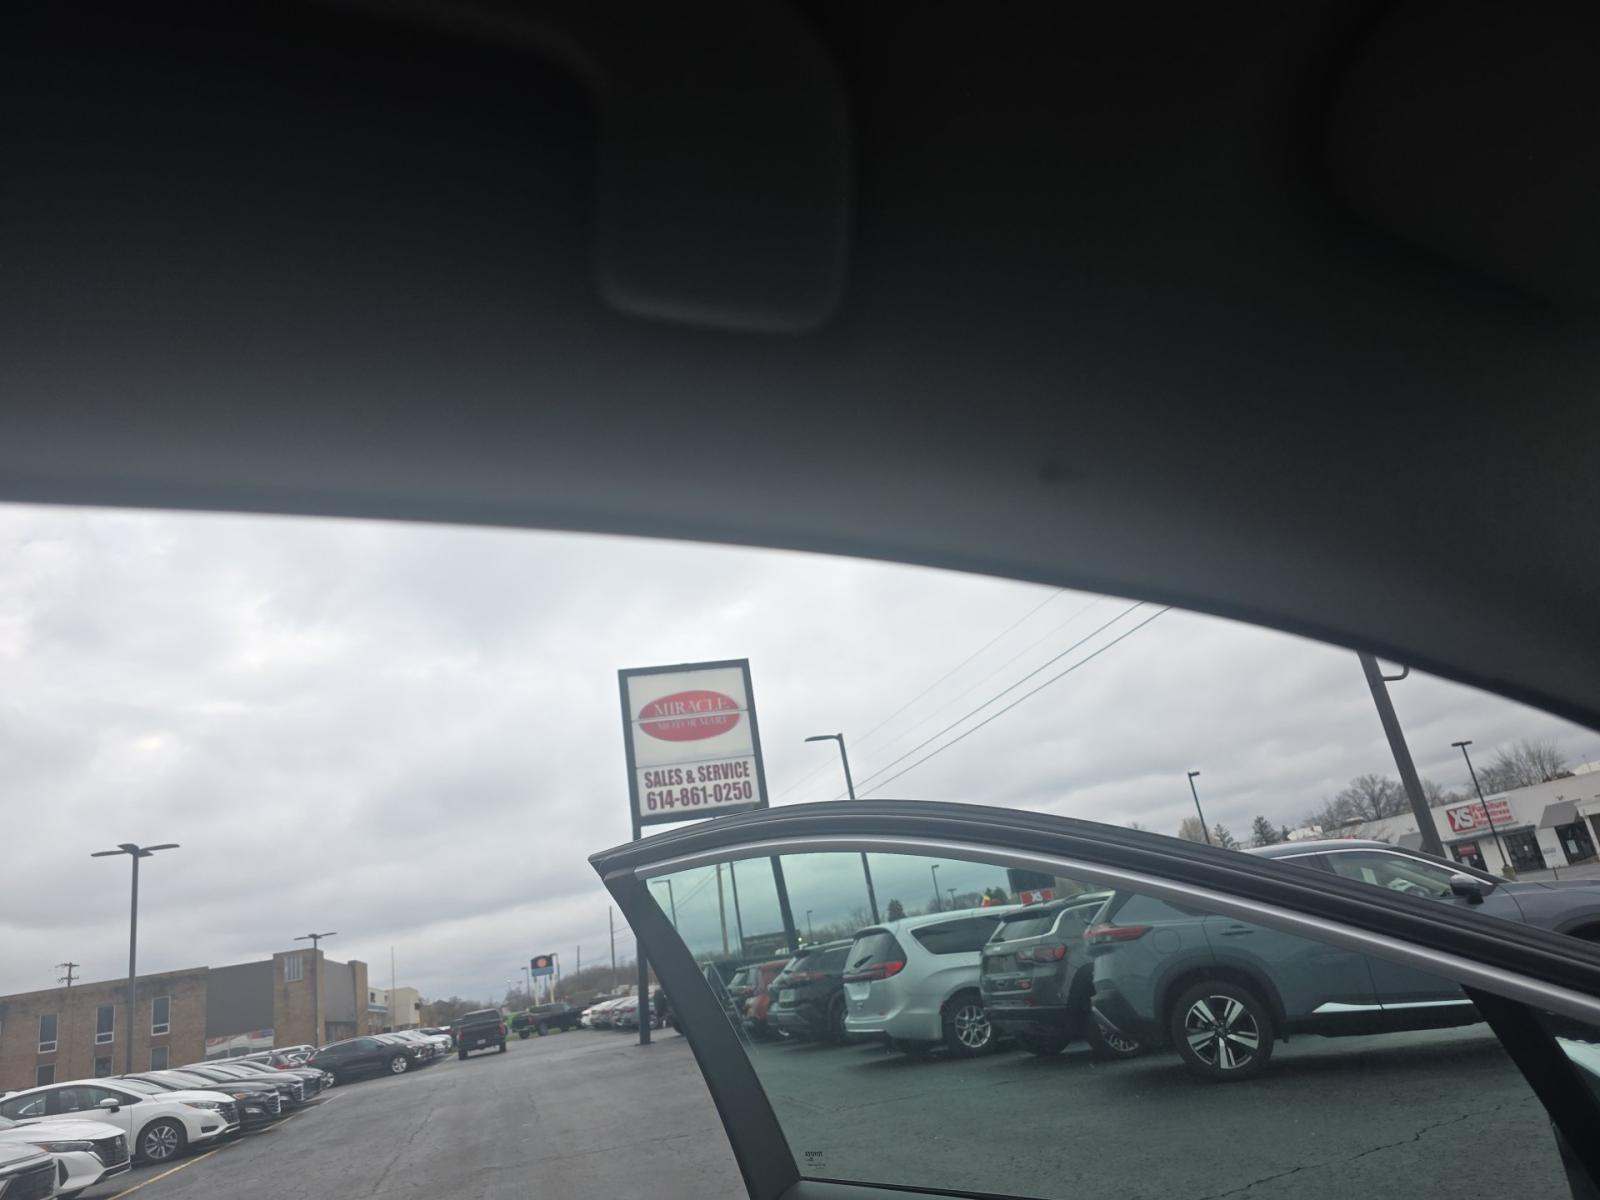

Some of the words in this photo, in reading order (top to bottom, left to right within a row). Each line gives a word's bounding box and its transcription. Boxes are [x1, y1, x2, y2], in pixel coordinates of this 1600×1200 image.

[655, 697, 729, 716] MIRACLE
[644, 768, 683, 789] SALES
[686, 769, 695, 784] &
[697, 761, 750, 782] SERVICE
[647, 780, 752, 810] 614-861-0250
